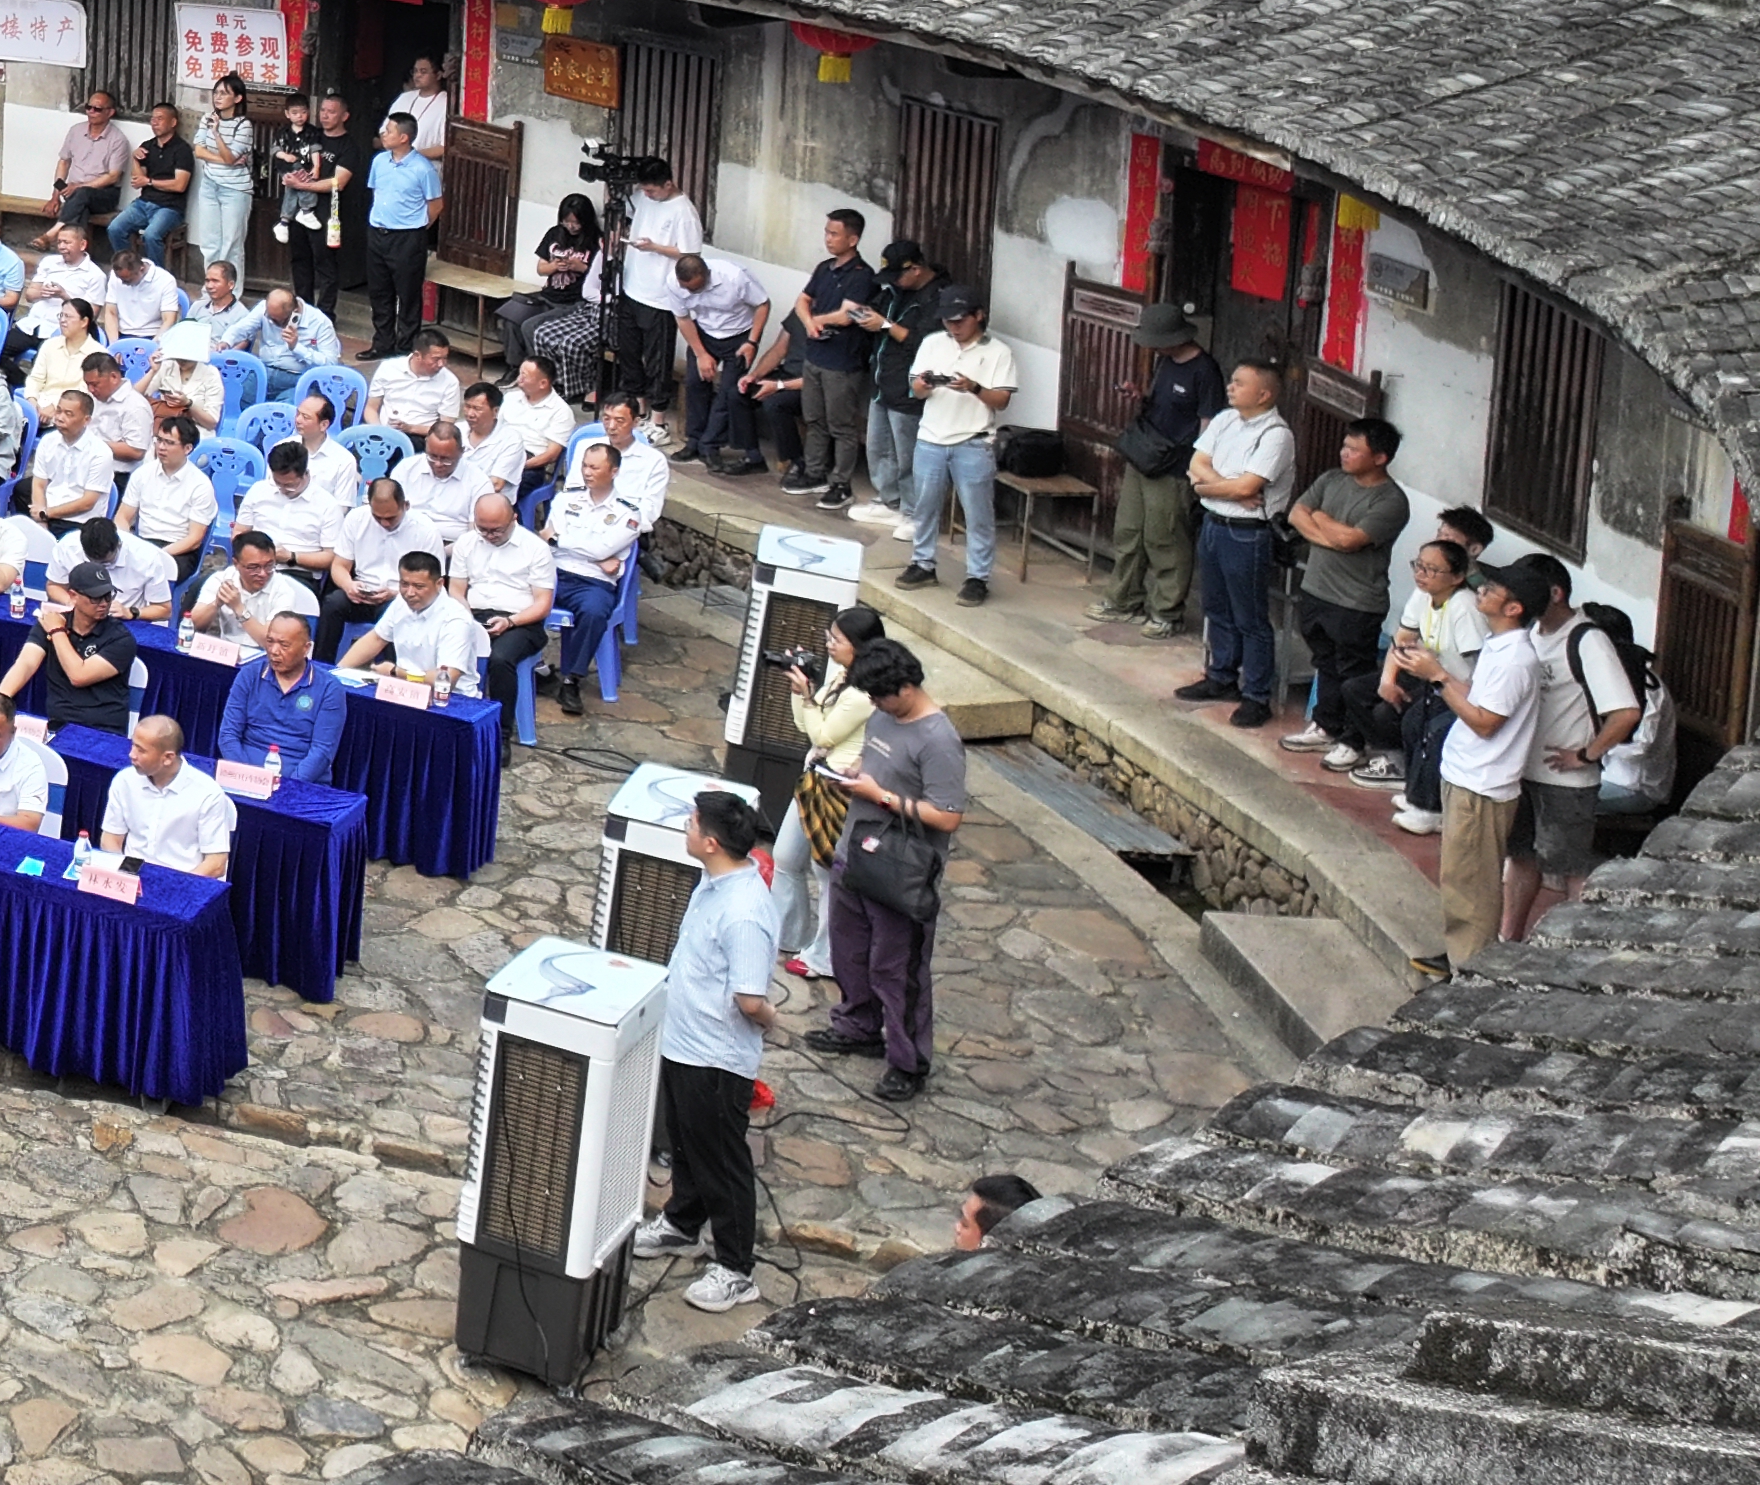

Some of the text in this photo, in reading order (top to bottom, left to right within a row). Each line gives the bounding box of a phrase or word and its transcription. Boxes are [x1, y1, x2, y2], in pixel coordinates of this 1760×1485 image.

[216, 13, 247, 29] 单元
[184, 28, 280, 61] 免费参观
[184, 54, 280, 85] 免费喝茶
